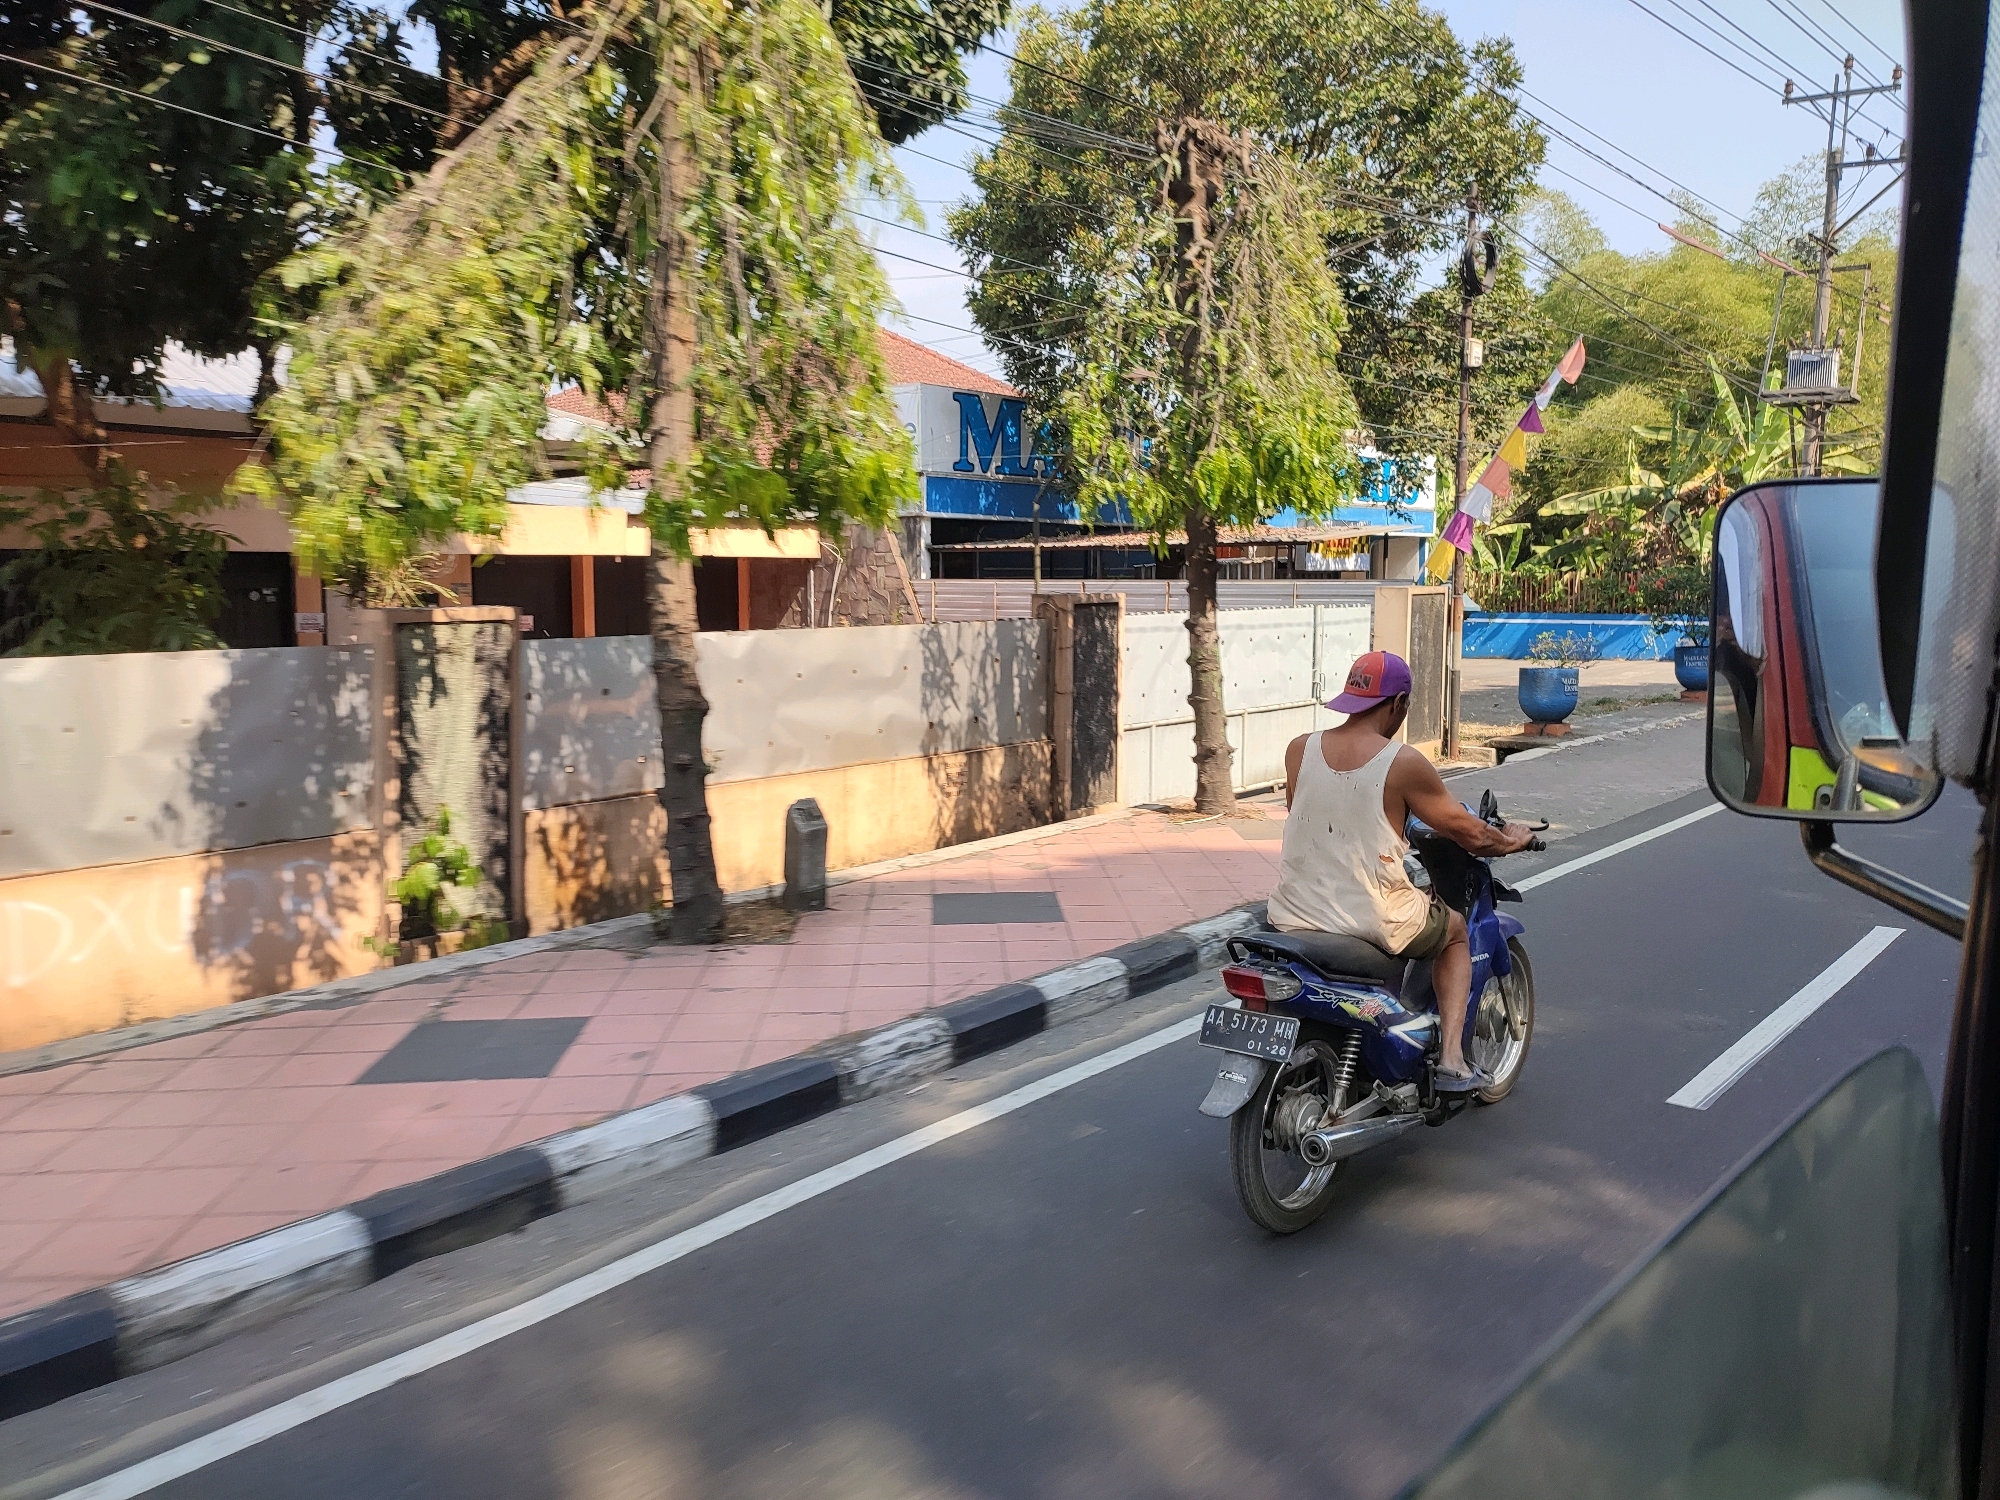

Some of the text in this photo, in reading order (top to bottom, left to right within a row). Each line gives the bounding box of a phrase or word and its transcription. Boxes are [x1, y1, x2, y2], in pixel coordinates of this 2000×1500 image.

[1308, 991, 1366, 1009] Supra
[1206, 1008, 1295, 1040] AA 5173 MH
